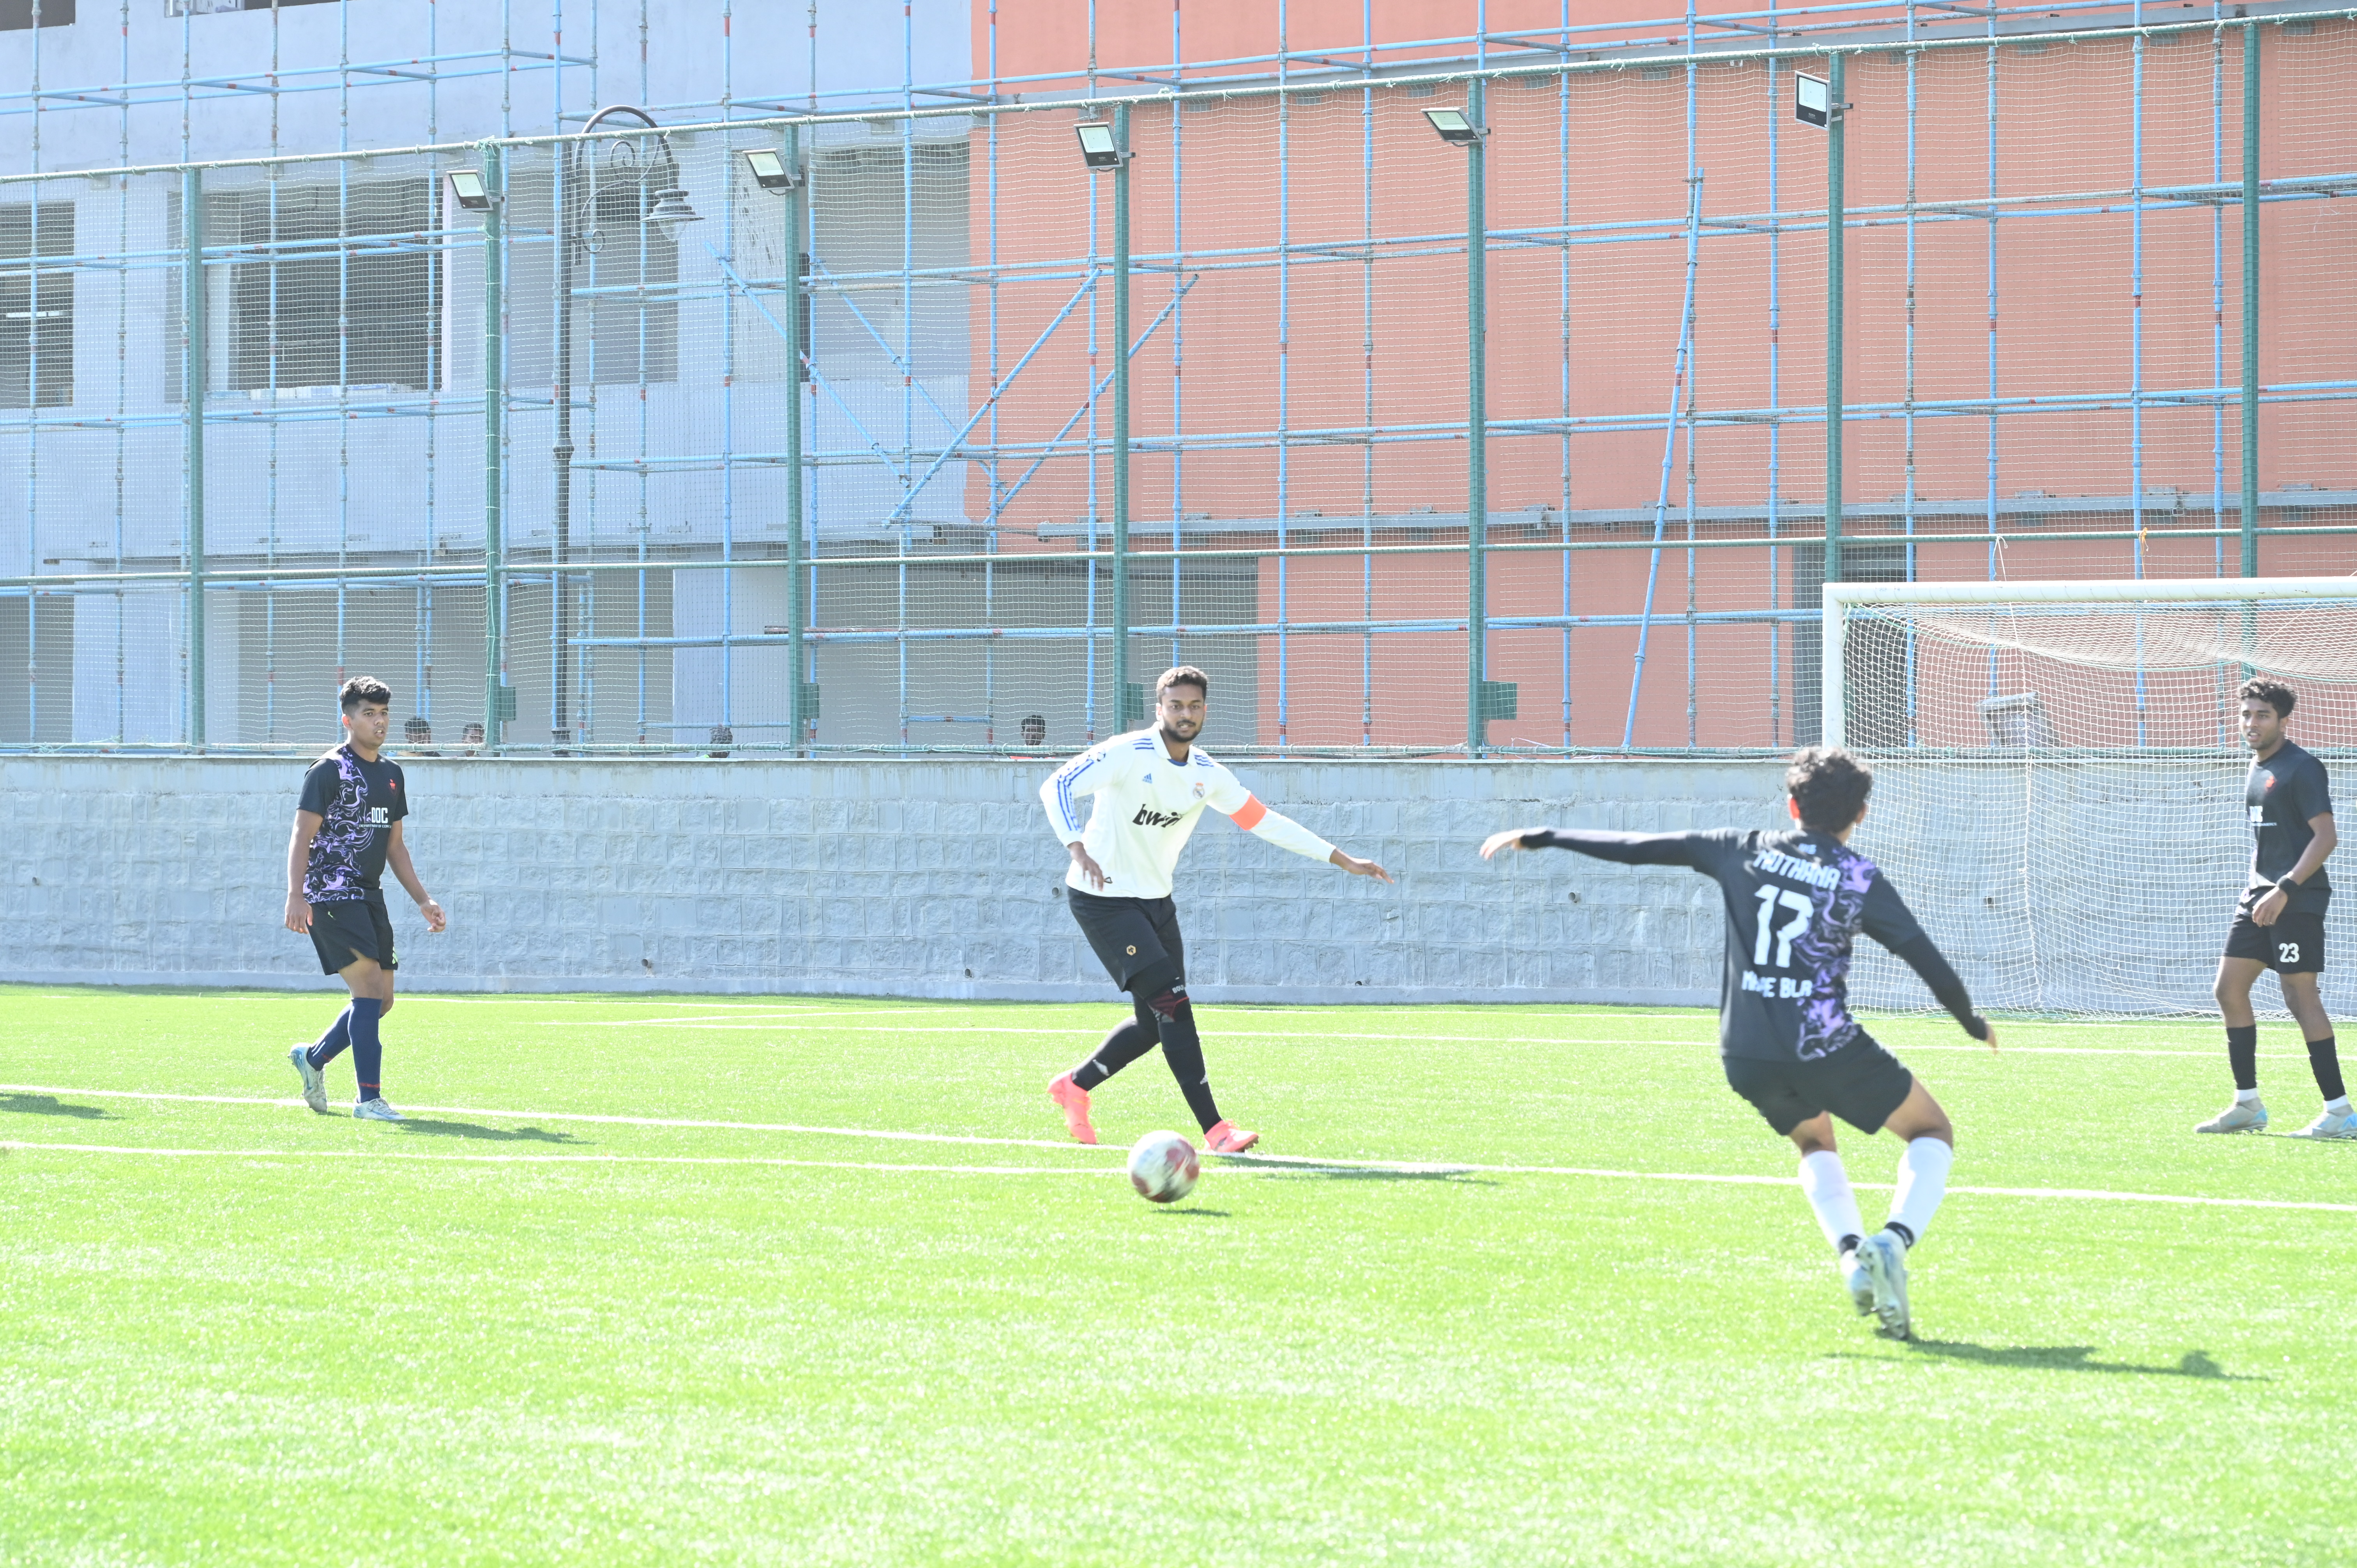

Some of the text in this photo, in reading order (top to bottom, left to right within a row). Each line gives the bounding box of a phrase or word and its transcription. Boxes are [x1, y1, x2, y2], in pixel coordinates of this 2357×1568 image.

[371, 807, 388, 823] DOC
[1754, 884, 1814, 968] 17
[2279, 943, 2300, 963] 23
